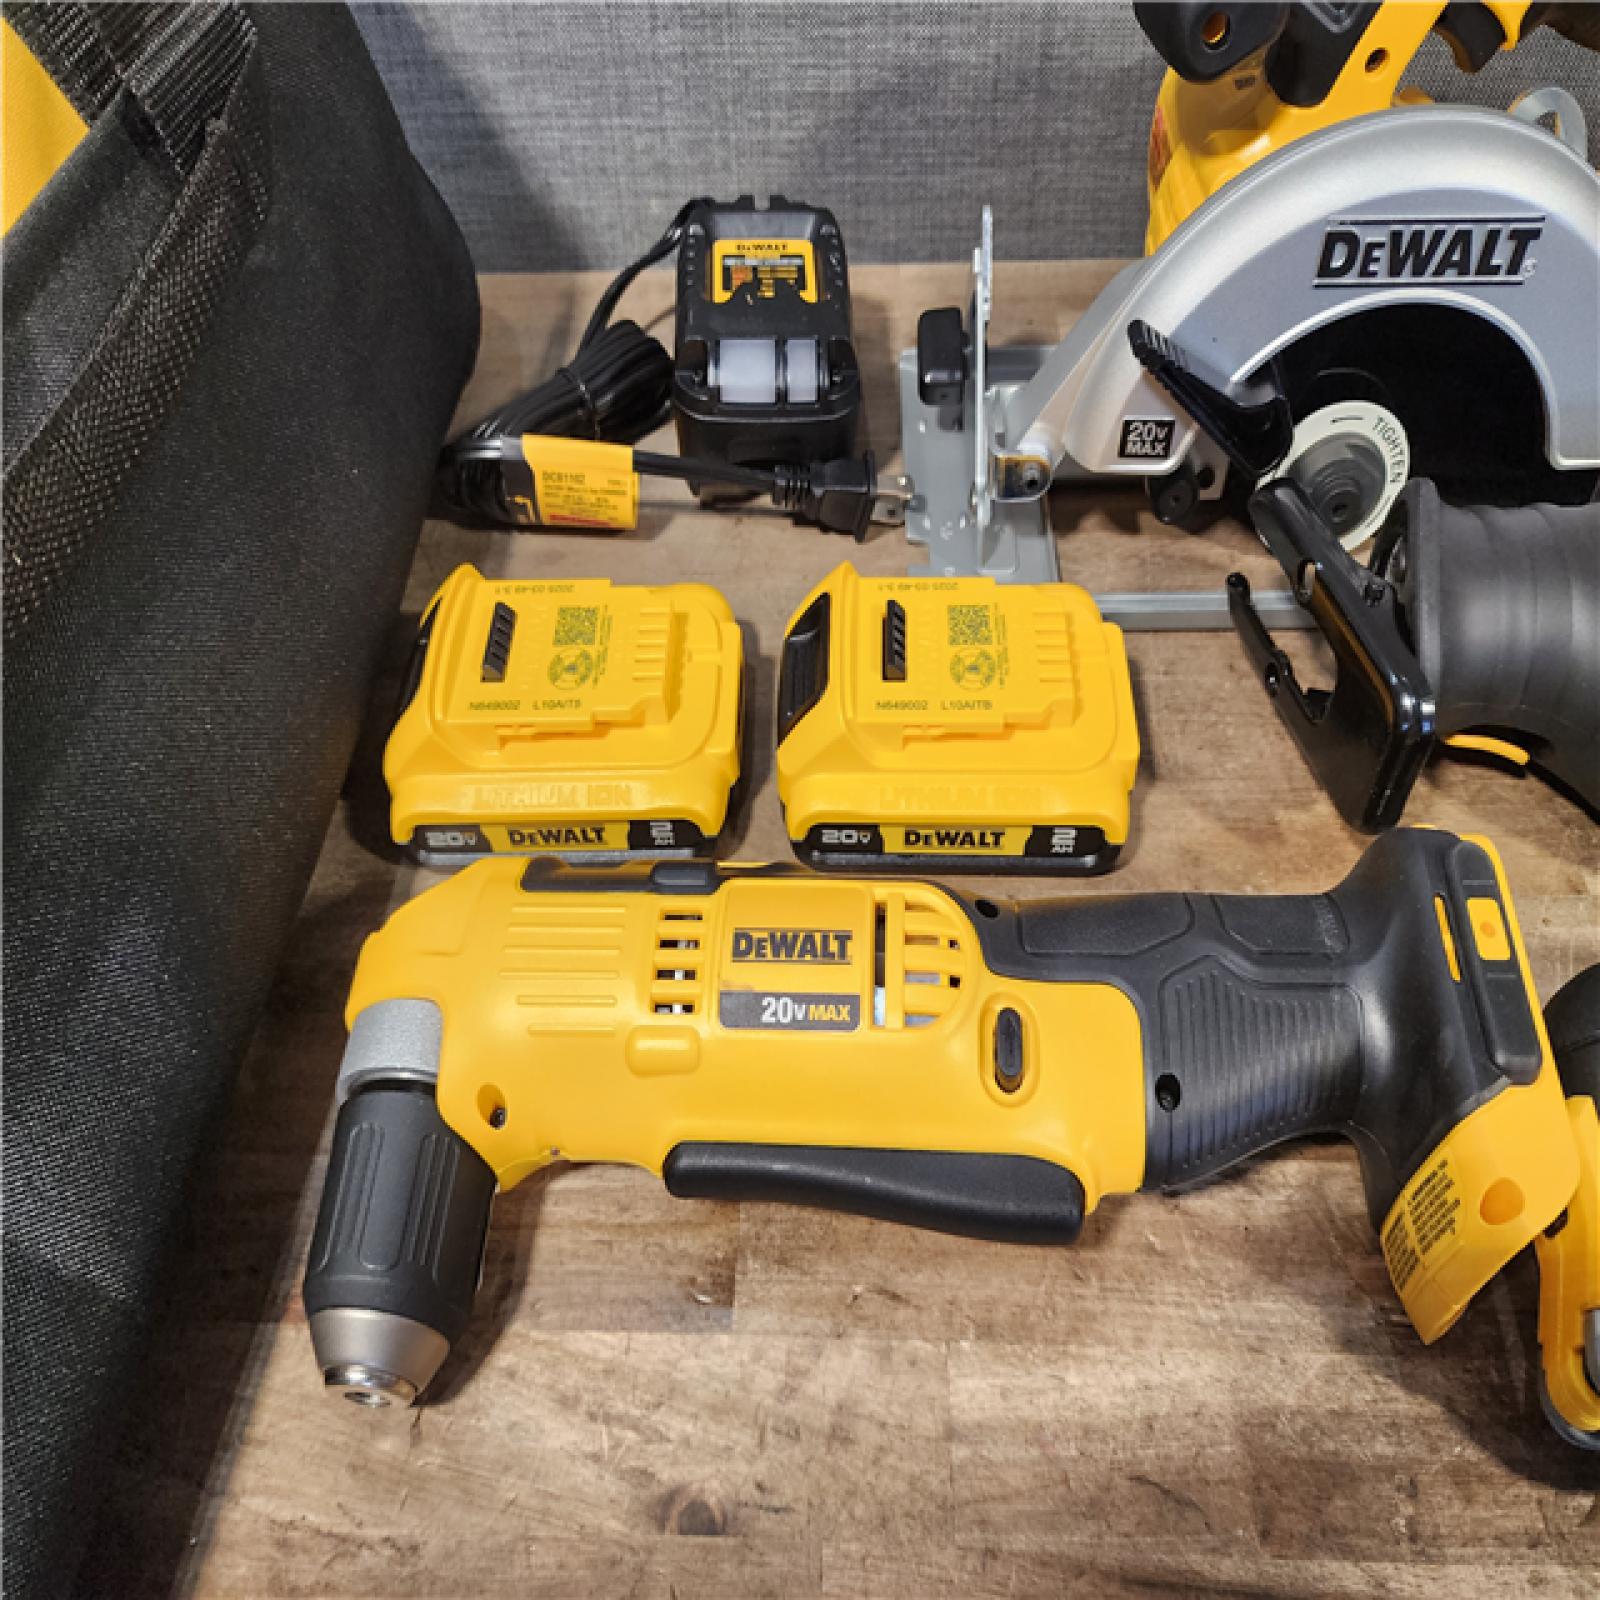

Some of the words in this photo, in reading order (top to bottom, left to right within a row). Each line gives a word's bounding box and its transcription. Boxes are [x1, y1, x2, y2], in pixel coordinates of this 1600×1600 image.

[1317, 227, 1543, 278] DEWALT
[1124, 441, 1166, 456] MAX
[1372, 415, 1404, 483] TIGHTEN
[473, 784, 580, 809] LITHIUM
[587, 784, 634, 809] ION
[508, 826, 606, 846] DEWALT
[904, 830, 1005, 848] DEWALT
[733, 931, 853, 960] DEWALT
[808, 1004, 850, 1021] MAX
